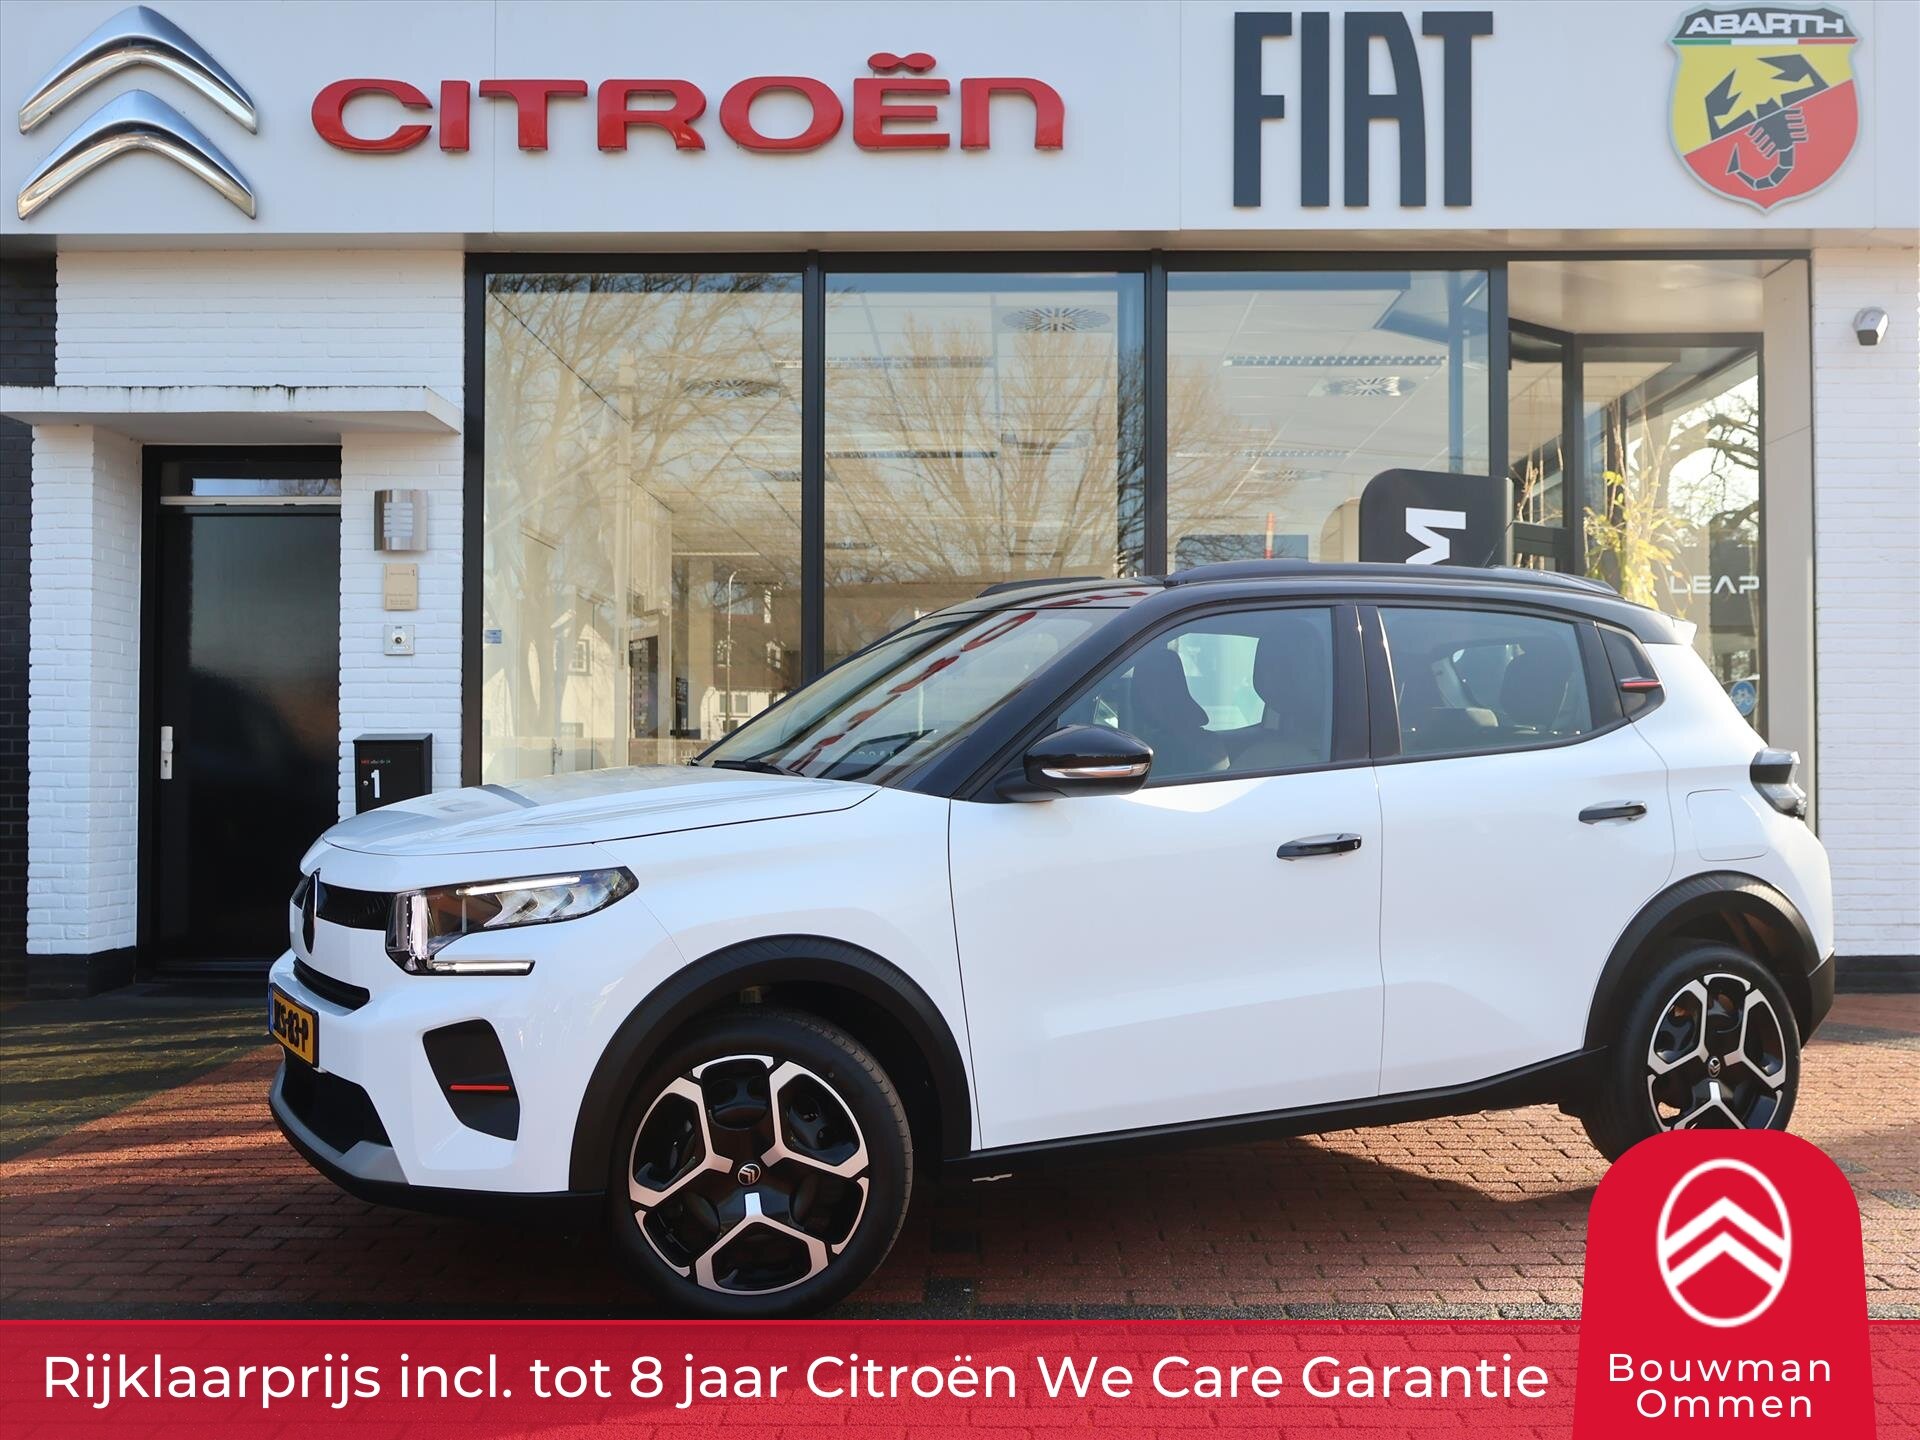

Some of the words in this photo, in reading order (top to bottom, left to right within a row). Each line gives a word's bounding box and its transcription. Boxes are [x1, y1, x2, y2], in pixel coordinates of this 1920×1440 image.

[1685, 12, 1845, 35] ABARTH
[311, 53, 1066, 153] CITROËN
[1233, 11, 1494, 208] FIAT
[1669, 575, 1760, 594] LEAP
[370, 769, 381, 799] 1
